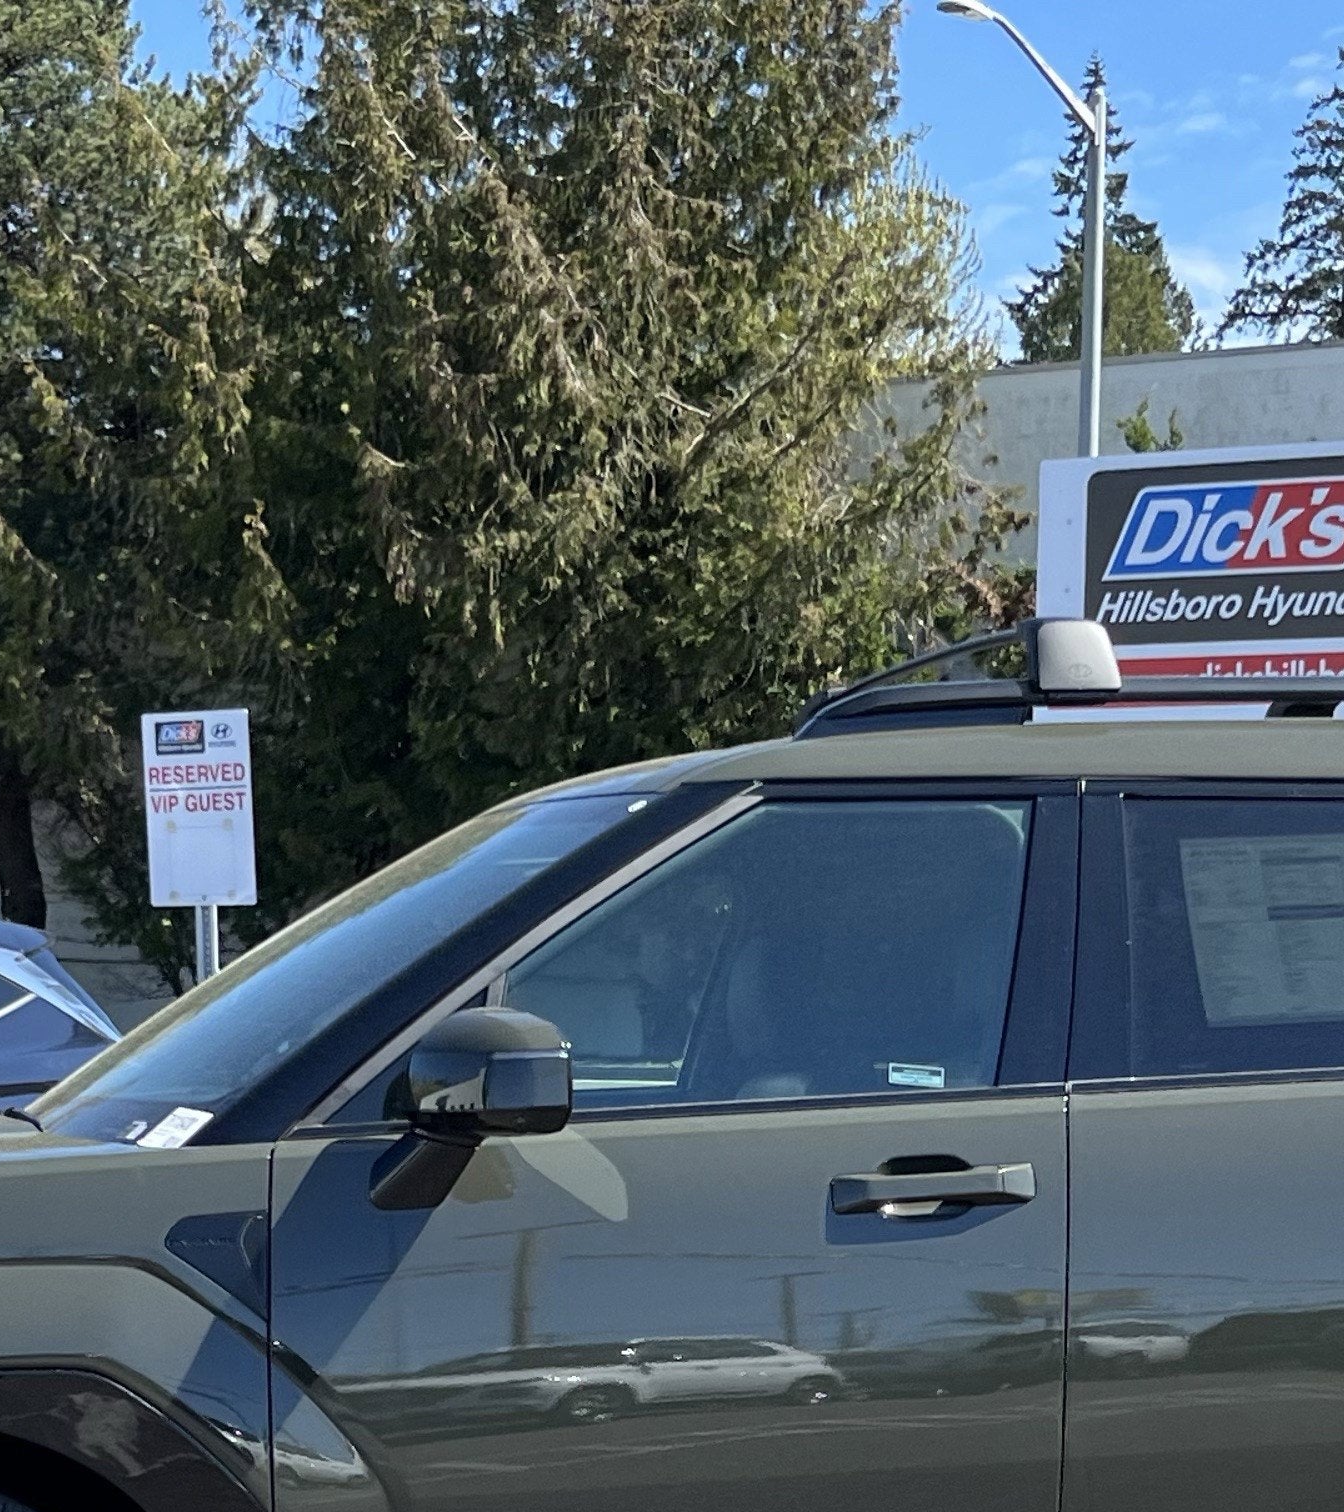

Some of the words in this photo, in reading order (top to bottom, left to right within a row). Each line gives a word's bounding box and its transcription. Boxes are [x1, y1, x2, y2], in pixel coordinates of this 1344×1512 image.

[1096, 587, 1242, 624] Hillsboro
[149, 762, 246, 785] RESERVED
[150, 794, 179, 813] VIP
[185, 792, 246, 812] GUEST
